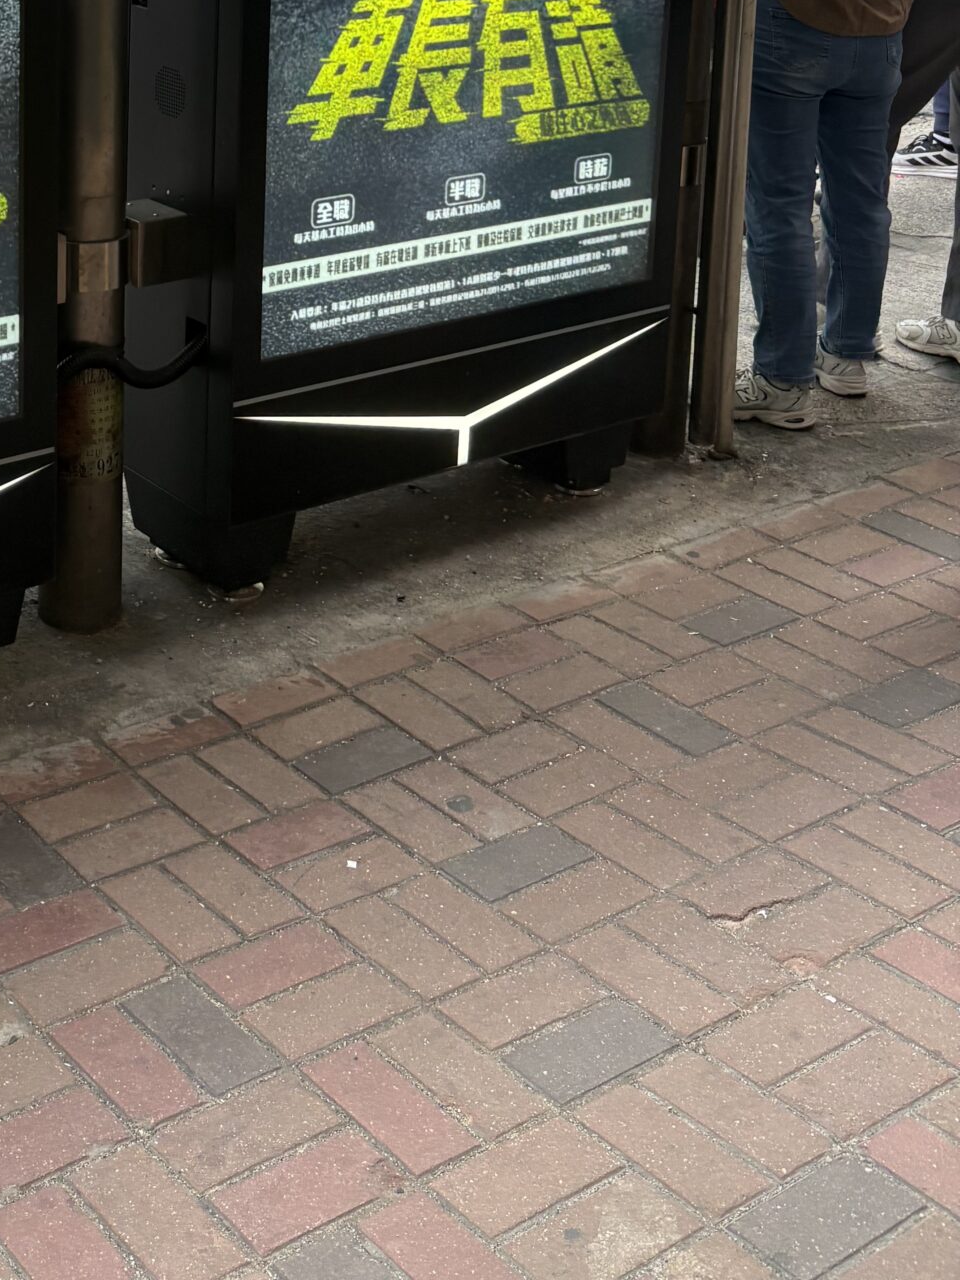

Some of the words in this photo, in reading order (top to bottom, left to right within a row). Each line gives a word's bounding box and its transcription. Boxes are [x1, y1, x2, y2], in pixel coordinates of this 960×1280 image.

[578, 157, 609, 180] 時薪
[449, 177, 482, 202] 半職
[315, 198, 351, 225] 全職
